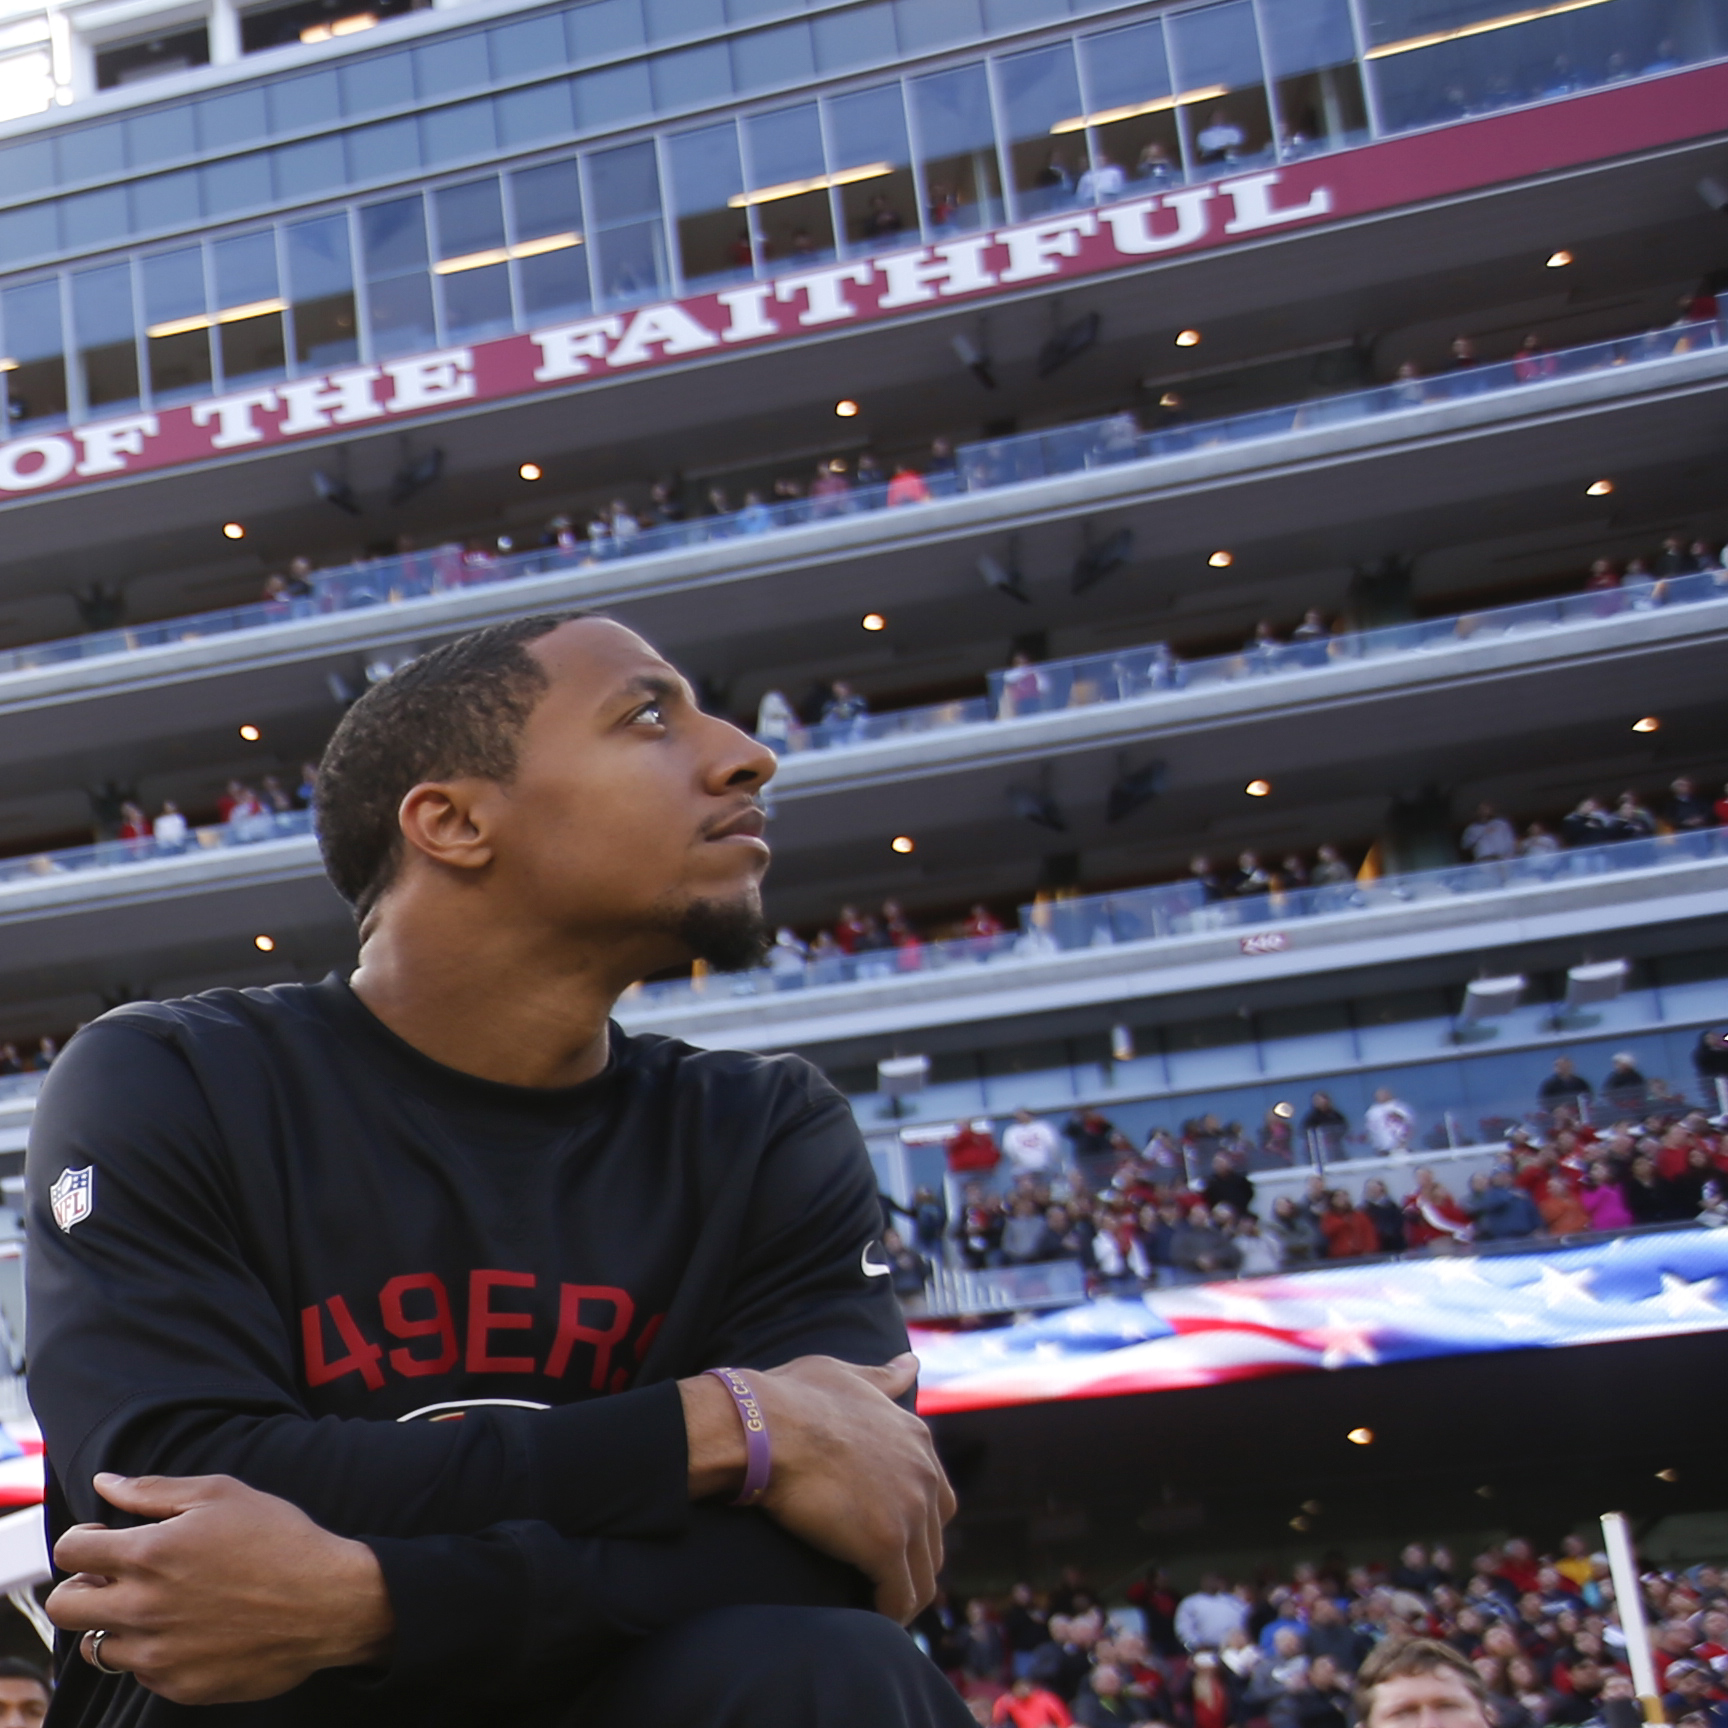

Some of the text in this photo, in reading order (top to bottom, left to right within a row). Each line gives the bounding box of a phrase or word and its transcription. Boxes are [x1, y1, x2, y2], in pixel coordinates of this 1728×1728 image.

[194, 346, 476, 449] THE
[531, 170, 1332, 383] FAITHFUL
[54, 1191, 85, 1226] NFL
